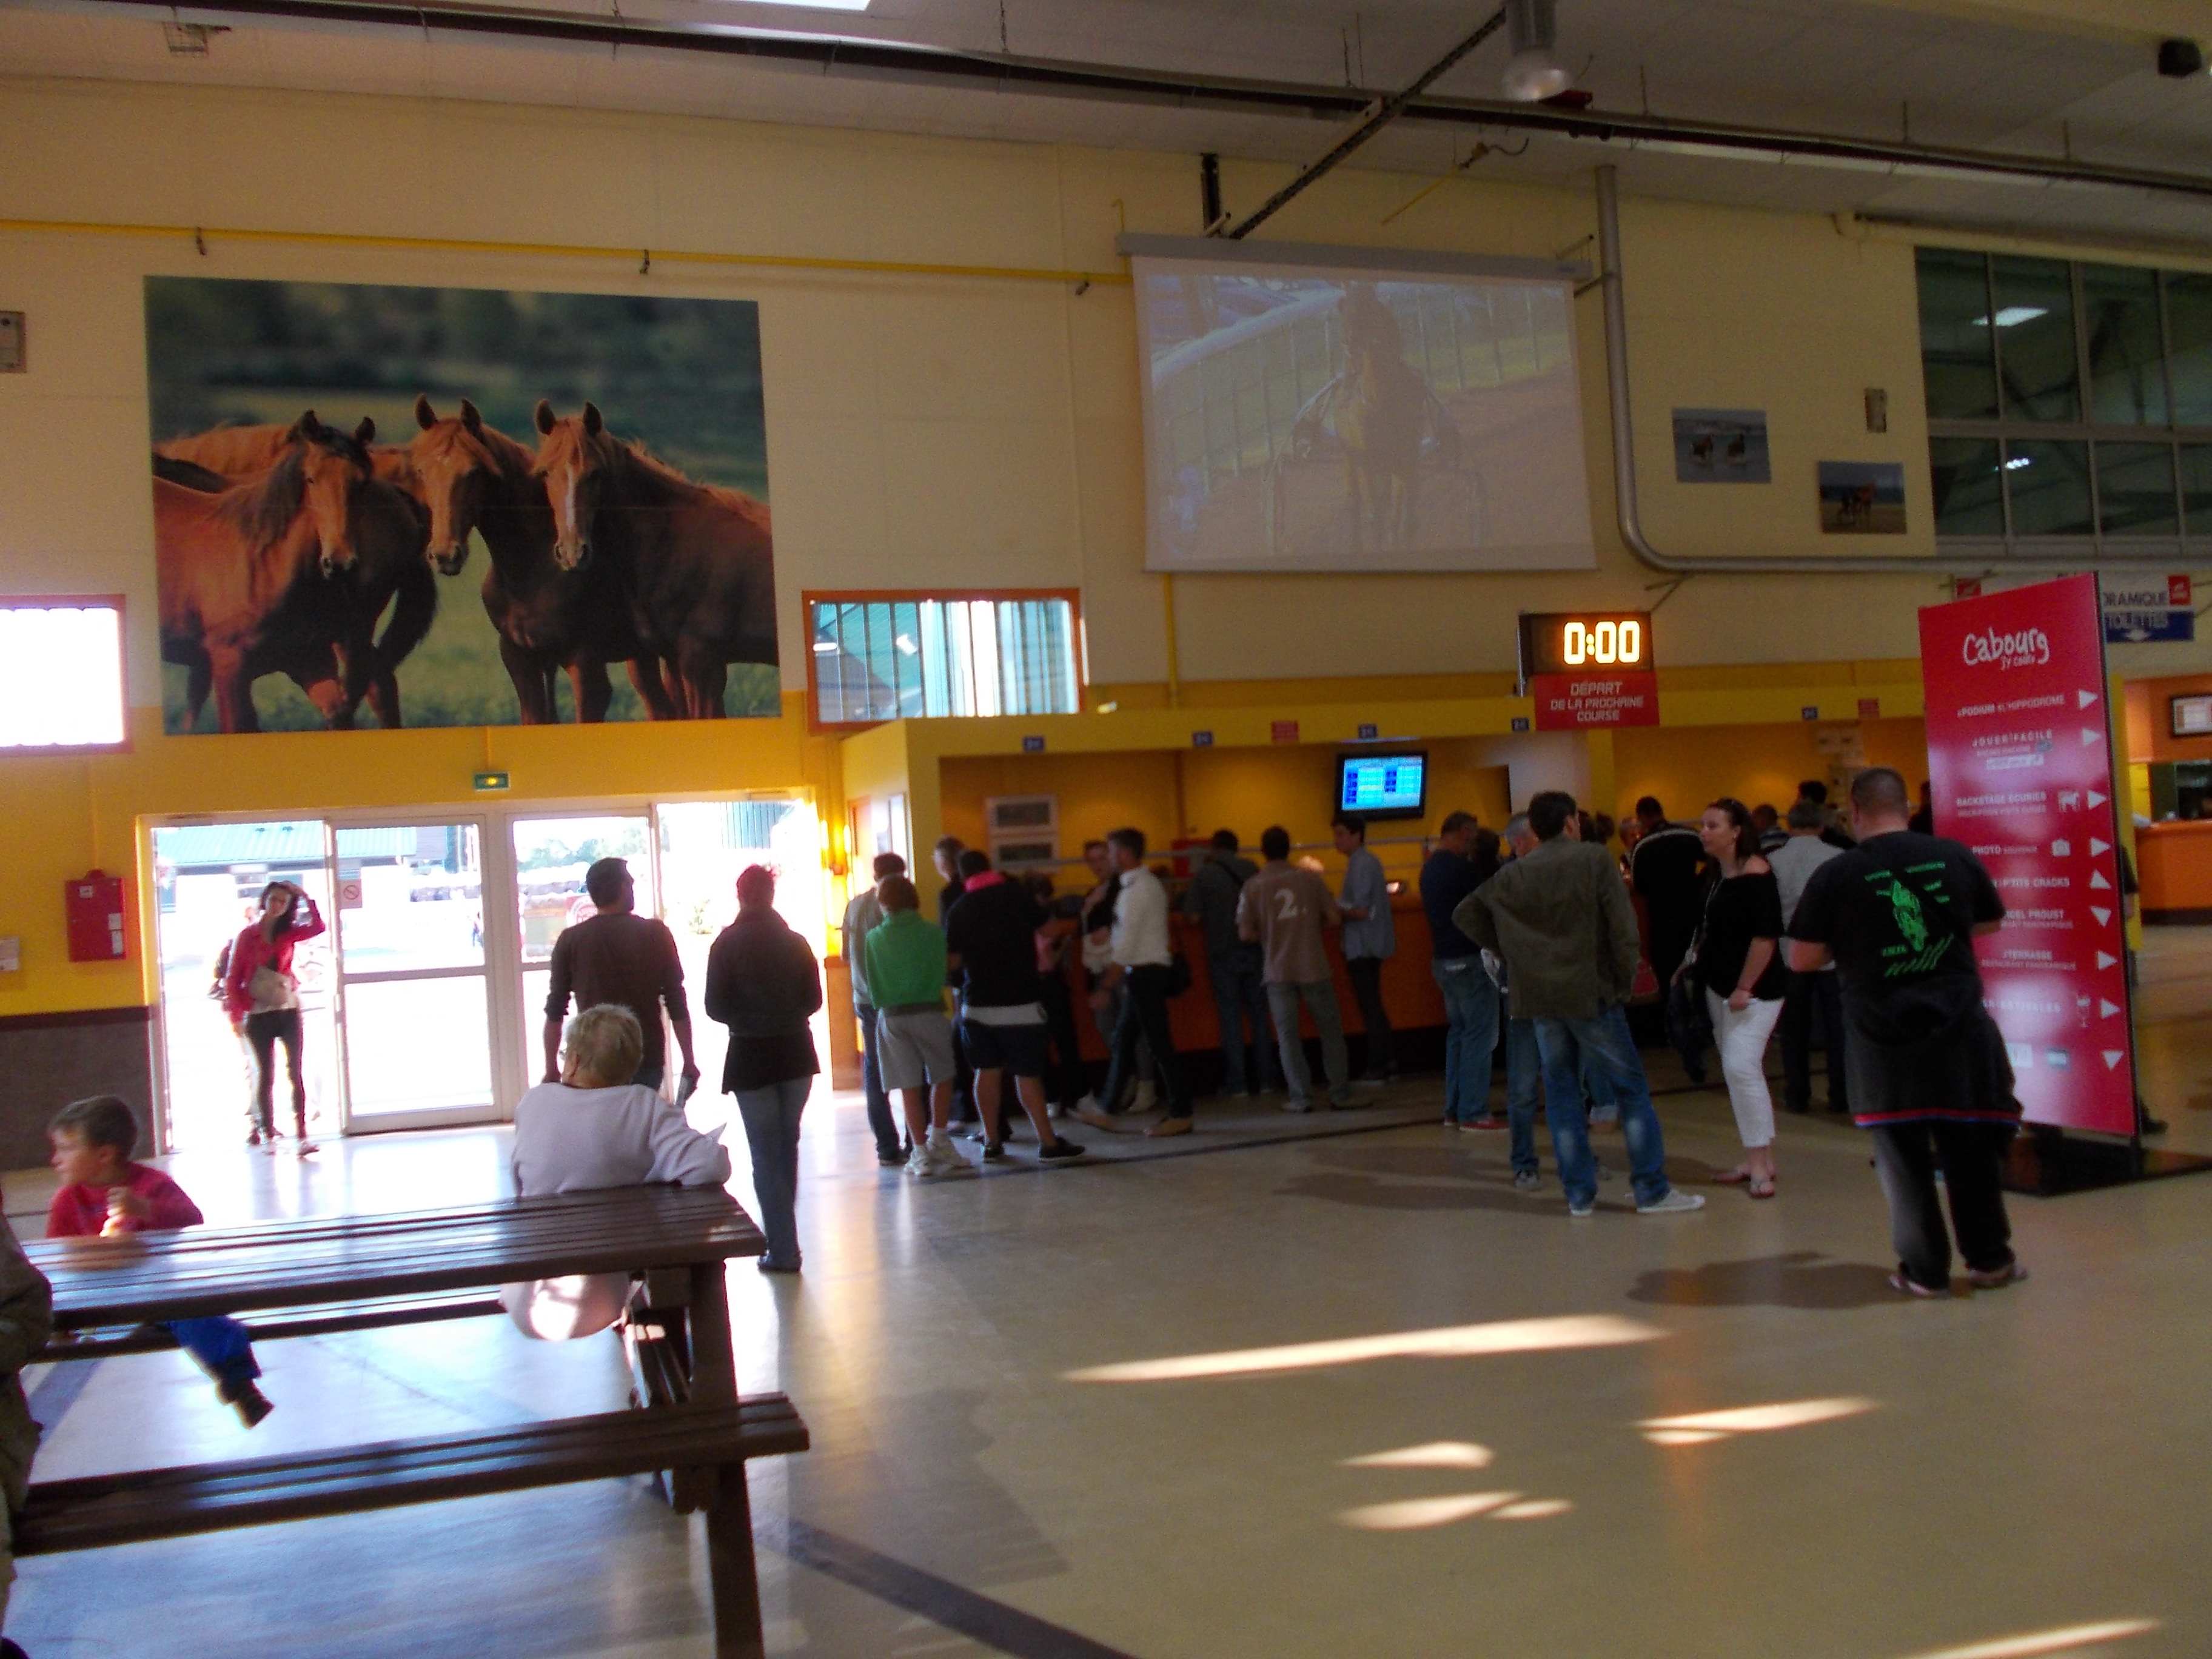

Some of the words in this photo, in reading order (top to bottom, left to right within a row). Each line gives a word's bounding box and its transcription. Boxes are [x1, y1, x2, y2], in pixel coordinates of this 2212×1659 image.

[1564, 620, 1640, 665] 0:00
[1963, 626, 2050, 666] Cabourg
[1550, 699, 1565, 711] DE
[1567, 698, 1582, 709] LA
[1585, 695, 1644, 709] PROCHAINE
[1577, 709, 1620, 722] COURSE
[1972, 844, 2001, 855] PHOTO
